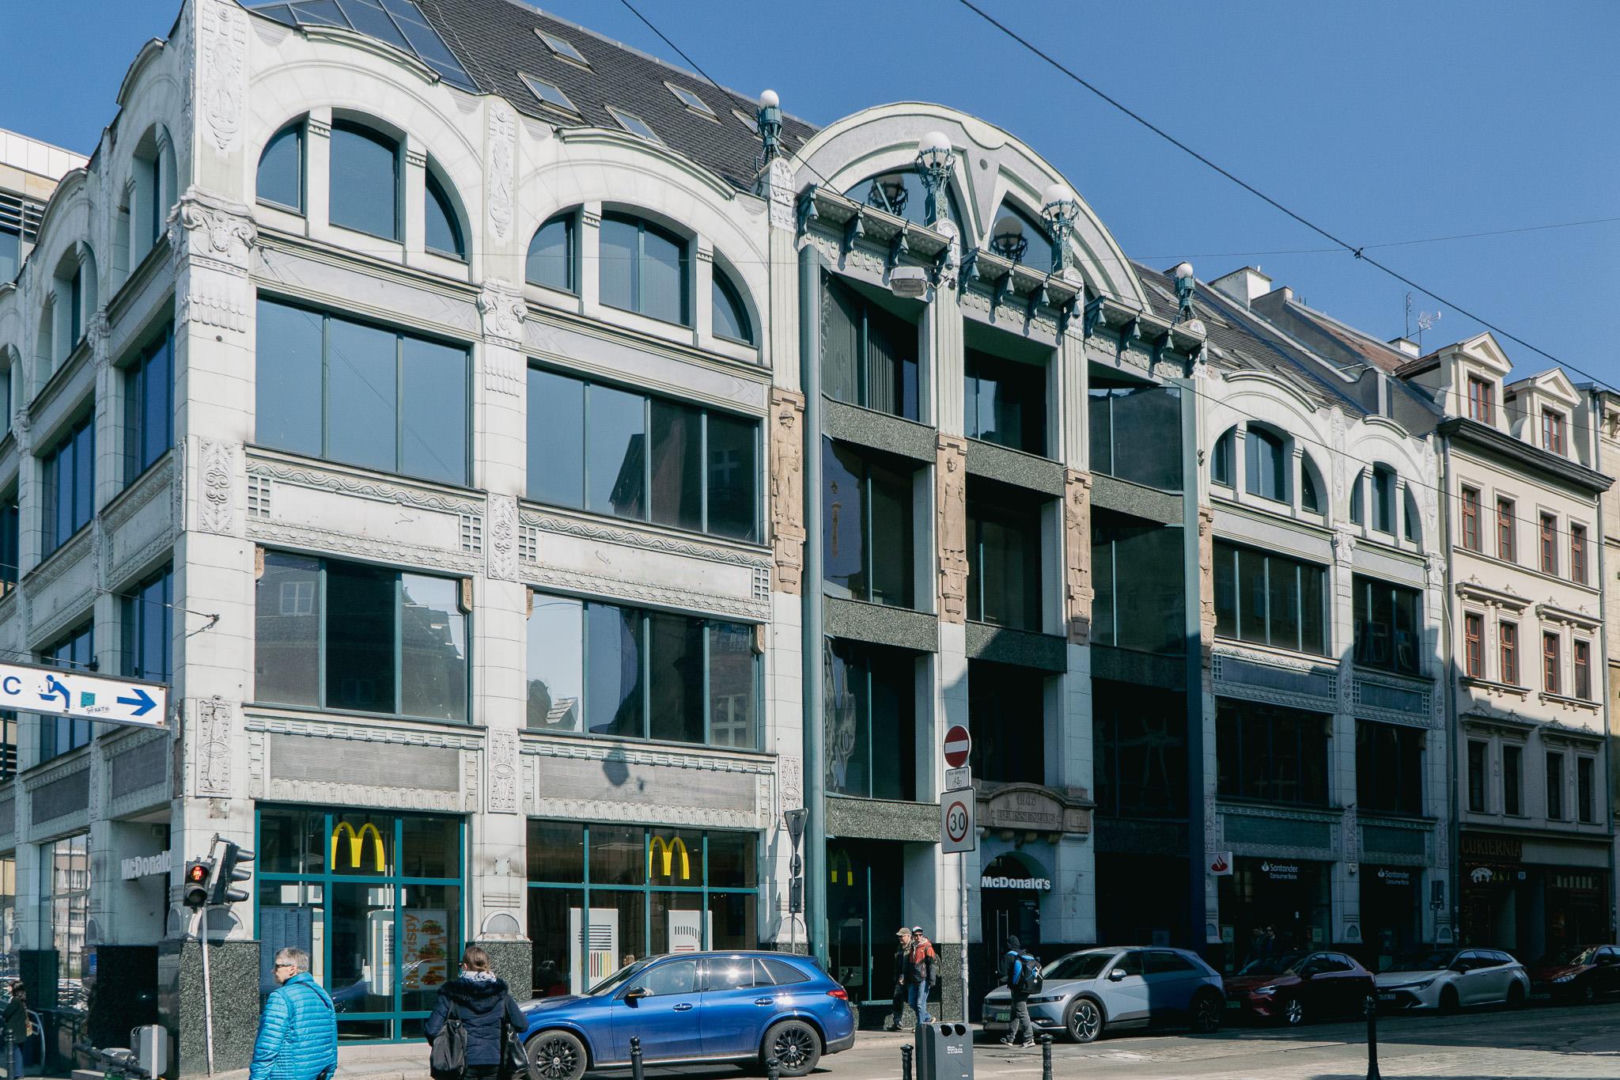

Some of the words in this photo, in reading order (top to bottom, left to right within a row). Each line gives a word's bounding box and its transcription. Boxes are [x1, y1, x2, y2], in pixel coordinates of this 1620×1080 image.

[0, 675, 21, 696] C
[950, 812, 966, 832] 30
[1269, 863, 1298, 873] Santander
[981, 876, 1051, 890] McDonald's
